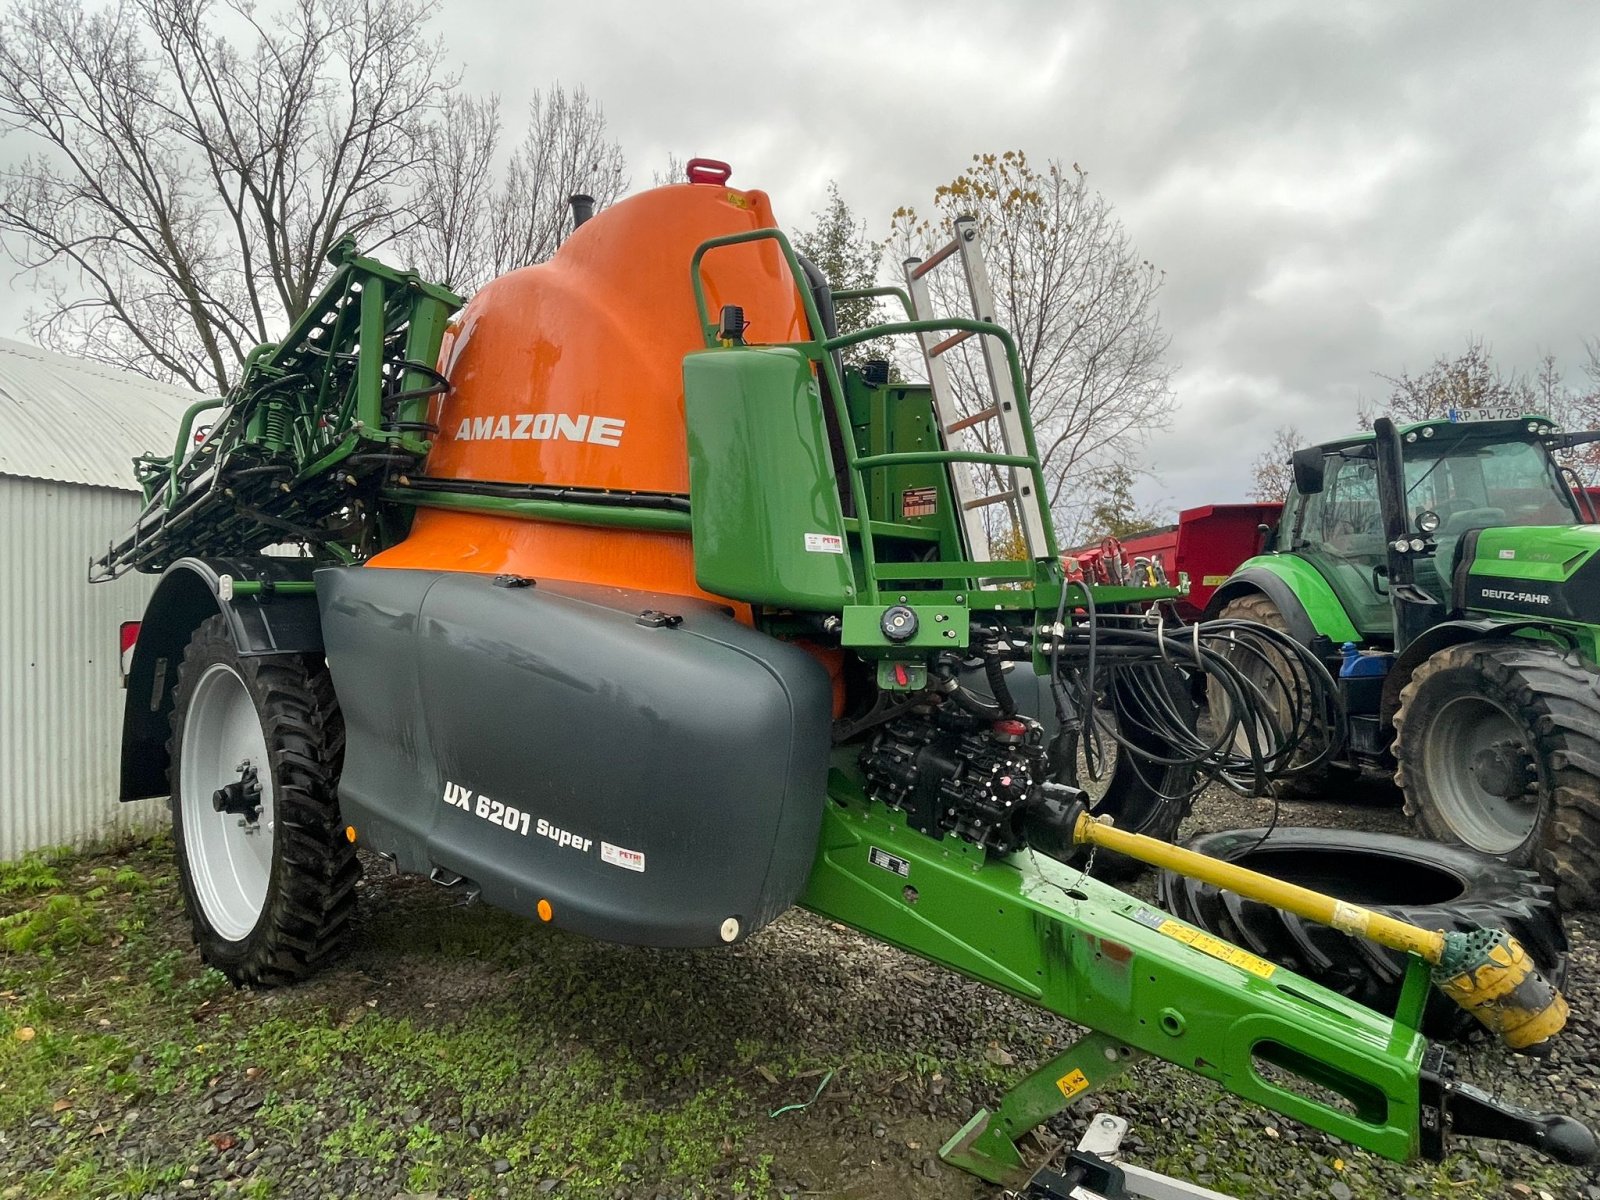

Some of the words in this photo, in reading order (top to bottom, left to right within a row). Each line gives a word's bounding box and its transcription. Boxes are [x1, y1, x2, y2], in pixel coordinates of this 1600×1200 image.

[1479, 410, 1495, 420] PL
[1497, 408, 1520, 419] 725
[454, 413, 626, 448] AMAZONE
[1481, 588, 1550, 605] DEUTZ-FAHR
[443, 781, 473, 812] UX
[475, 795, 531, 837] 6201
[536, 818, 593, 853] Super
